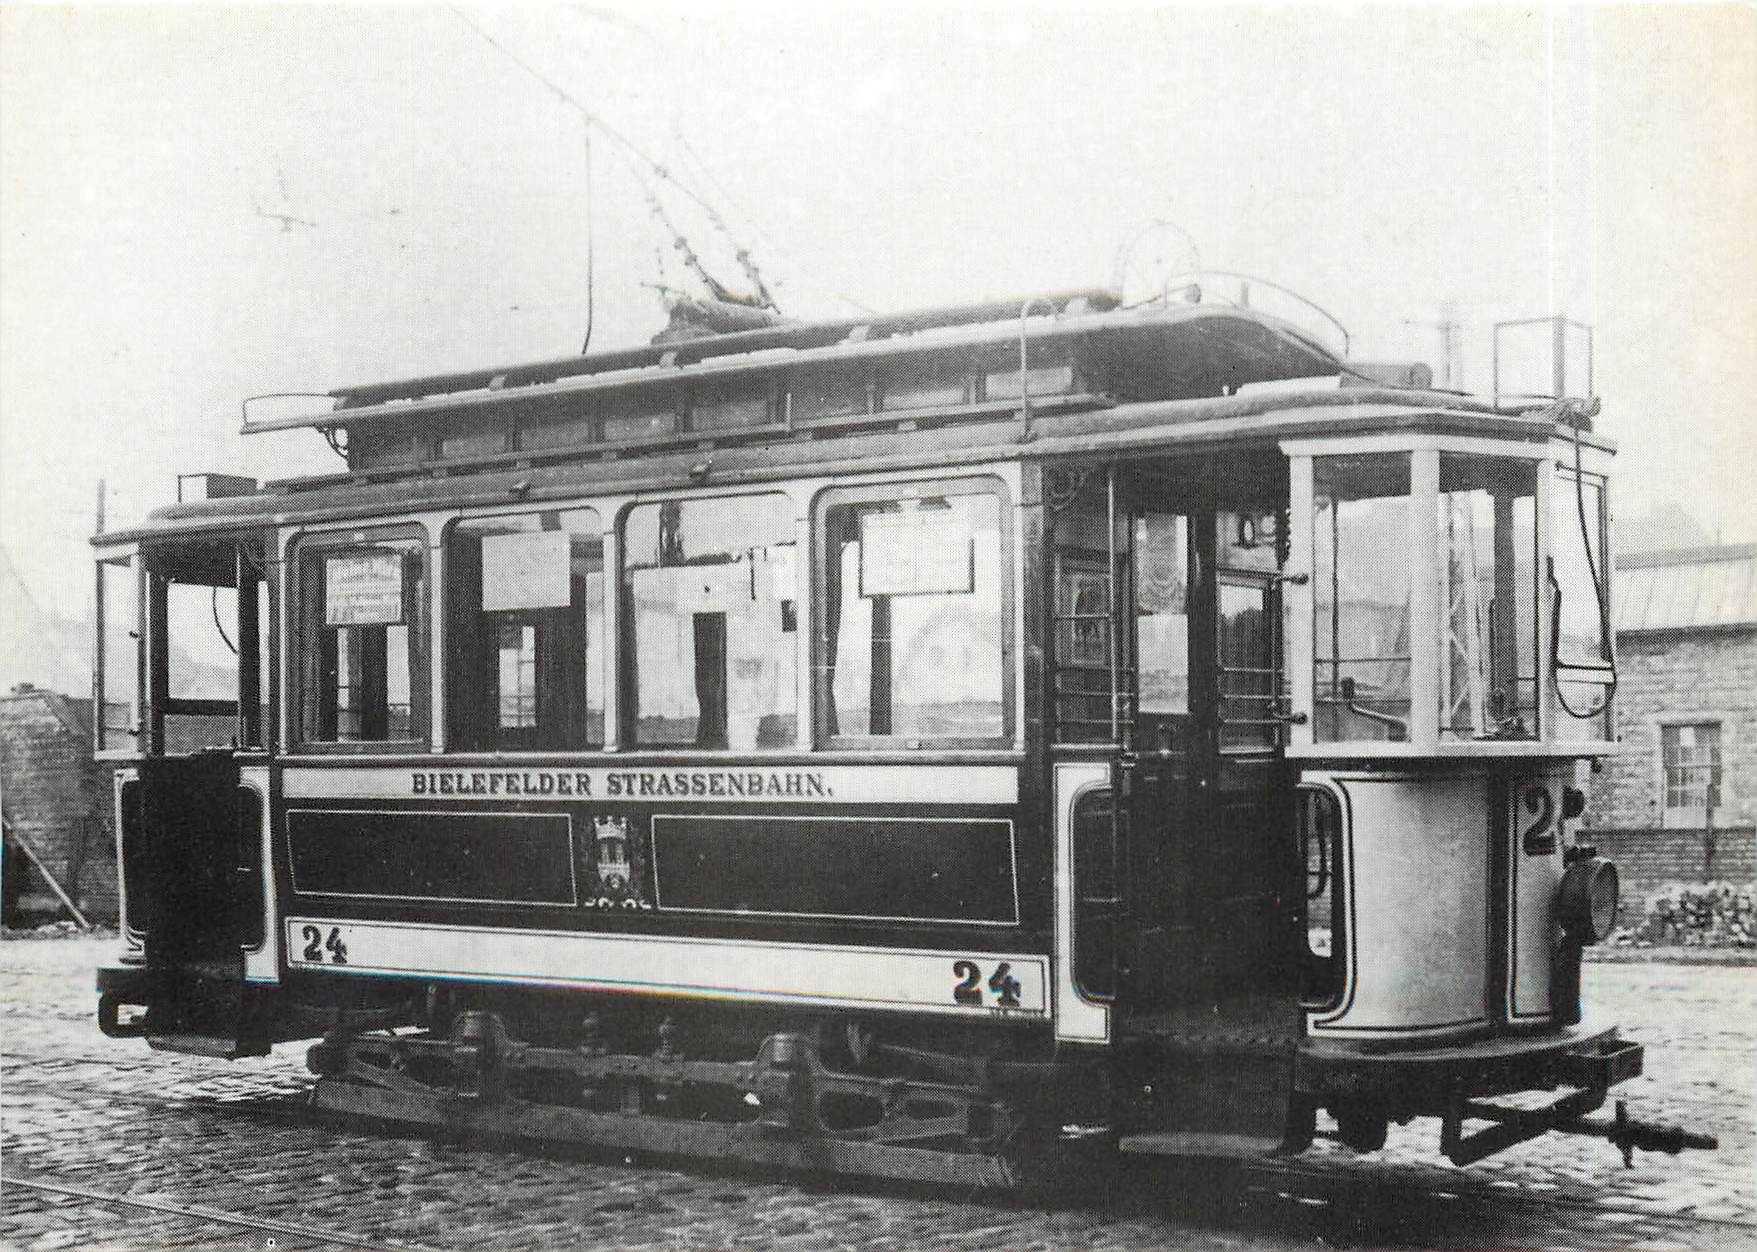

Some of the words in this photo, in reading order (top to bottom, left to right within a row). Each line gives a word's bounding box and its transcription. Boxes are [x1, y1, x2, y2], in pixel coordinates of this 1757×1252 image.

[412, 772, 592, 796] BIELEFELDER
[606, 772, 834, 797] STRASSENBAHN.
[1521, 784, 1564, 857] 2
[302, 924, 348, 964] 24
[952, 960, 1021, 1008] 24
